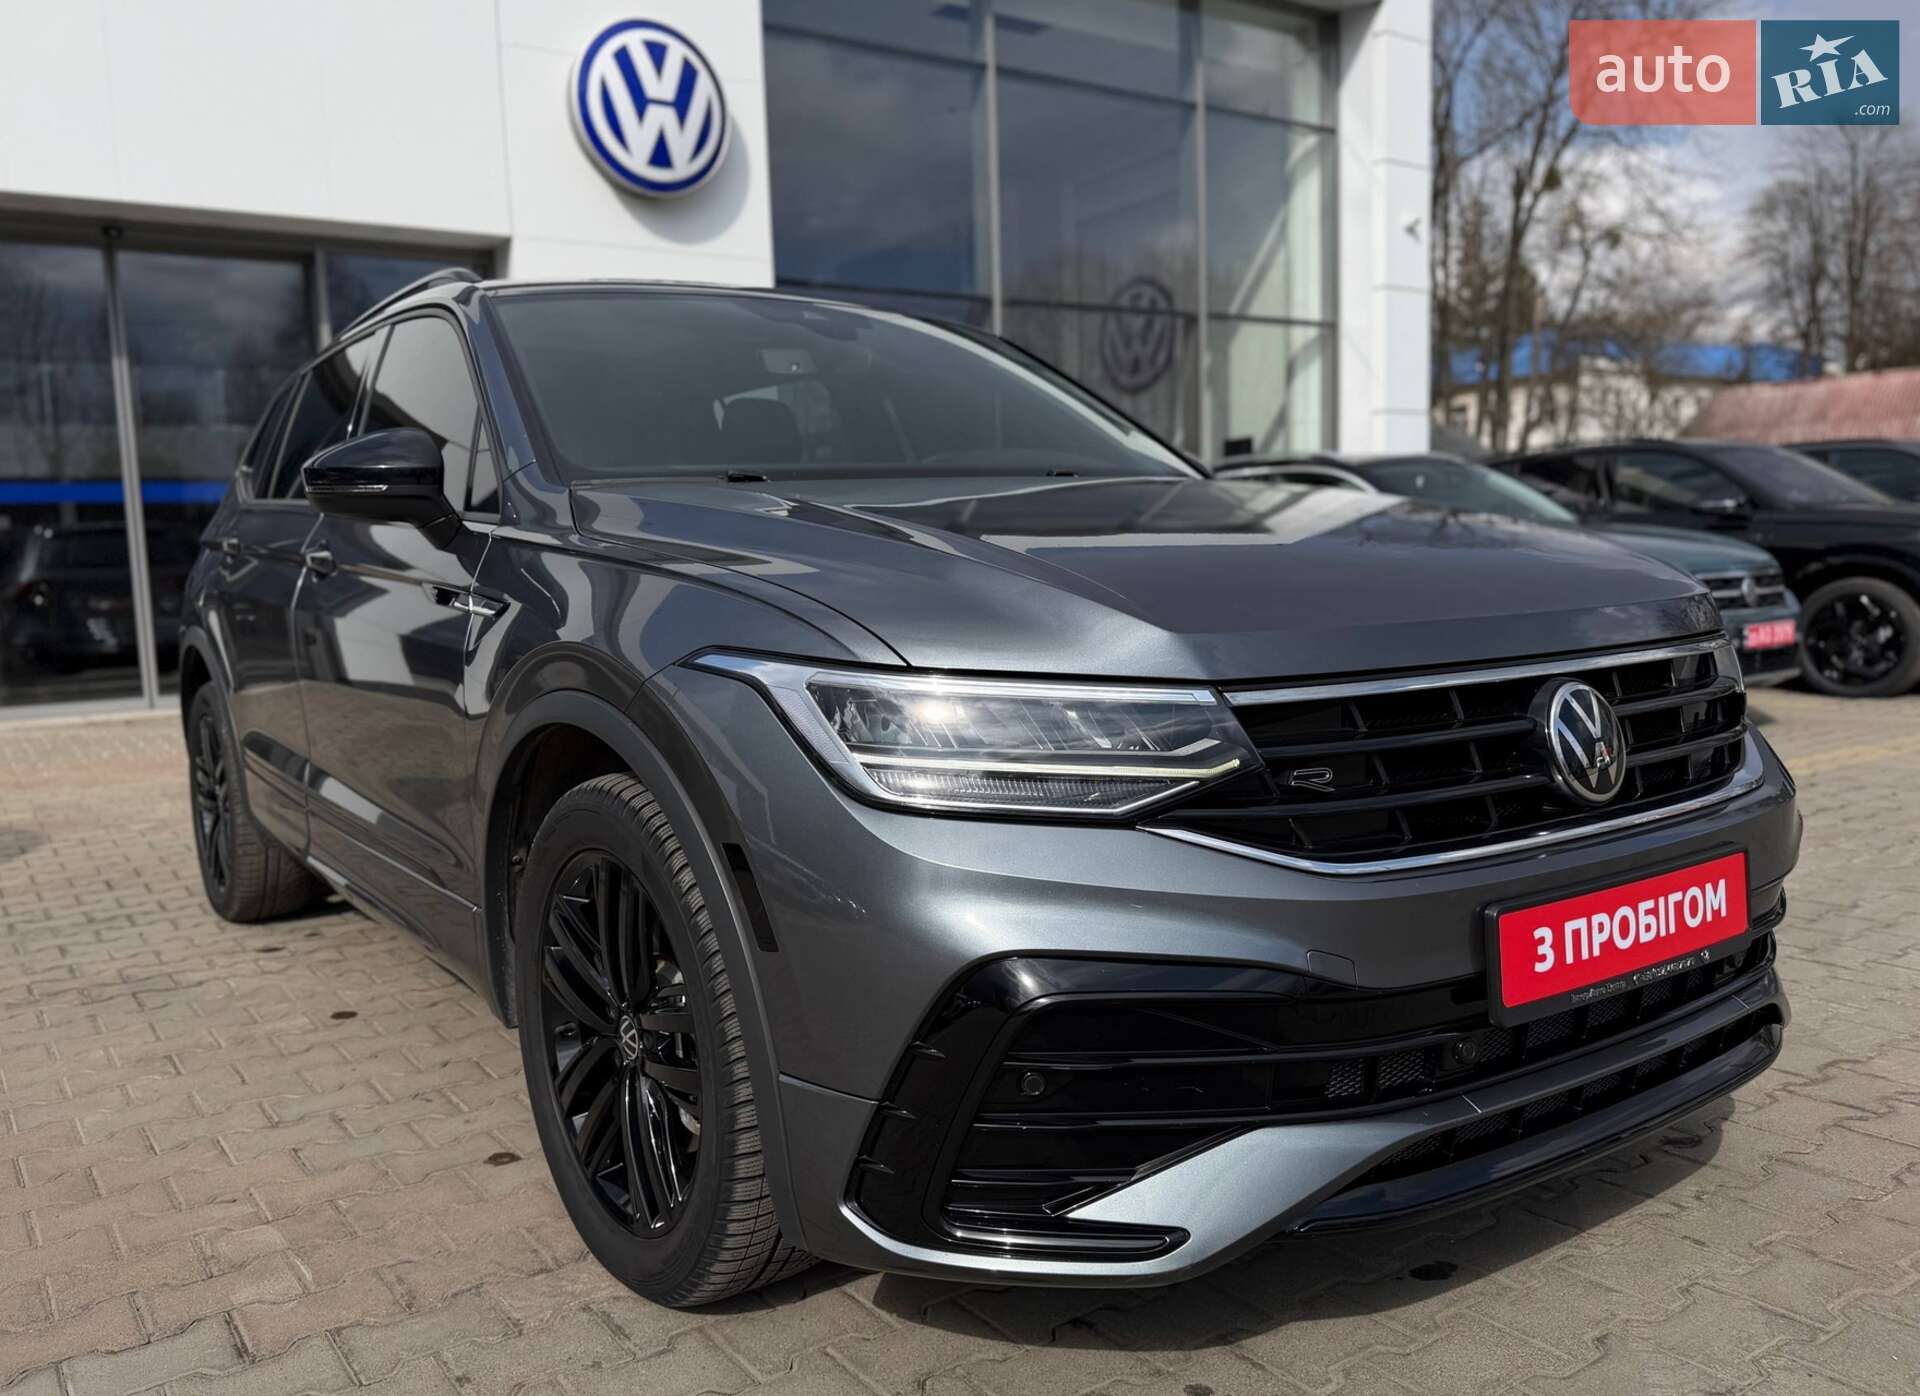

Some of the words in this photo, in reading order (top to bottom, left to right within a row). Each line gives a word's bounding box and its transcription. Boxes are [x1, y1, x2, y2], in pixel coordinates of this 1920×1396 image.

[585, 27, 724, 183] VW
[1288, 767, 1336, 792] R
[1551, 682, 1626, 802] VW
[1564, 878, 1728, 965] ПРОБІГОМ
